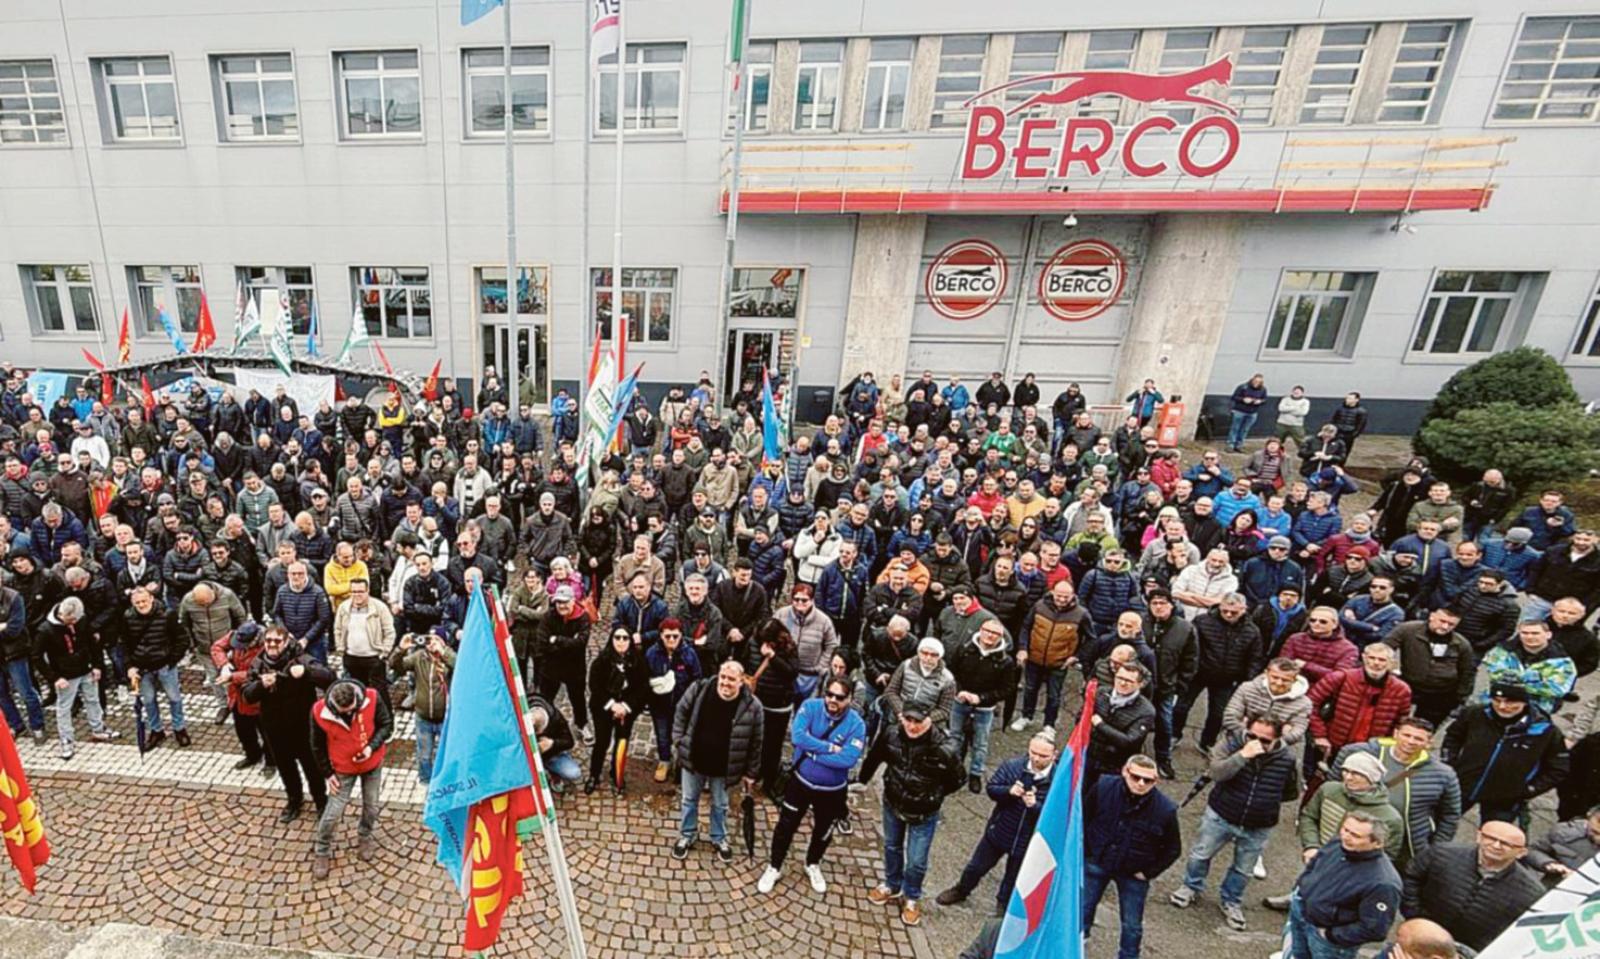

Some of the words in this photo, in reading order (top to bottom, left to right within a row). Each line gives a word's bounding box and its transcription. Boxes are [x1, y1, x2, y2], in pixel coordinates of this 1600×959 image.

[961, 105, 1240, 179] BERCO
[935, 273, 996, 292] BERCO
[1049, 274, 1112, 293] BERCO
